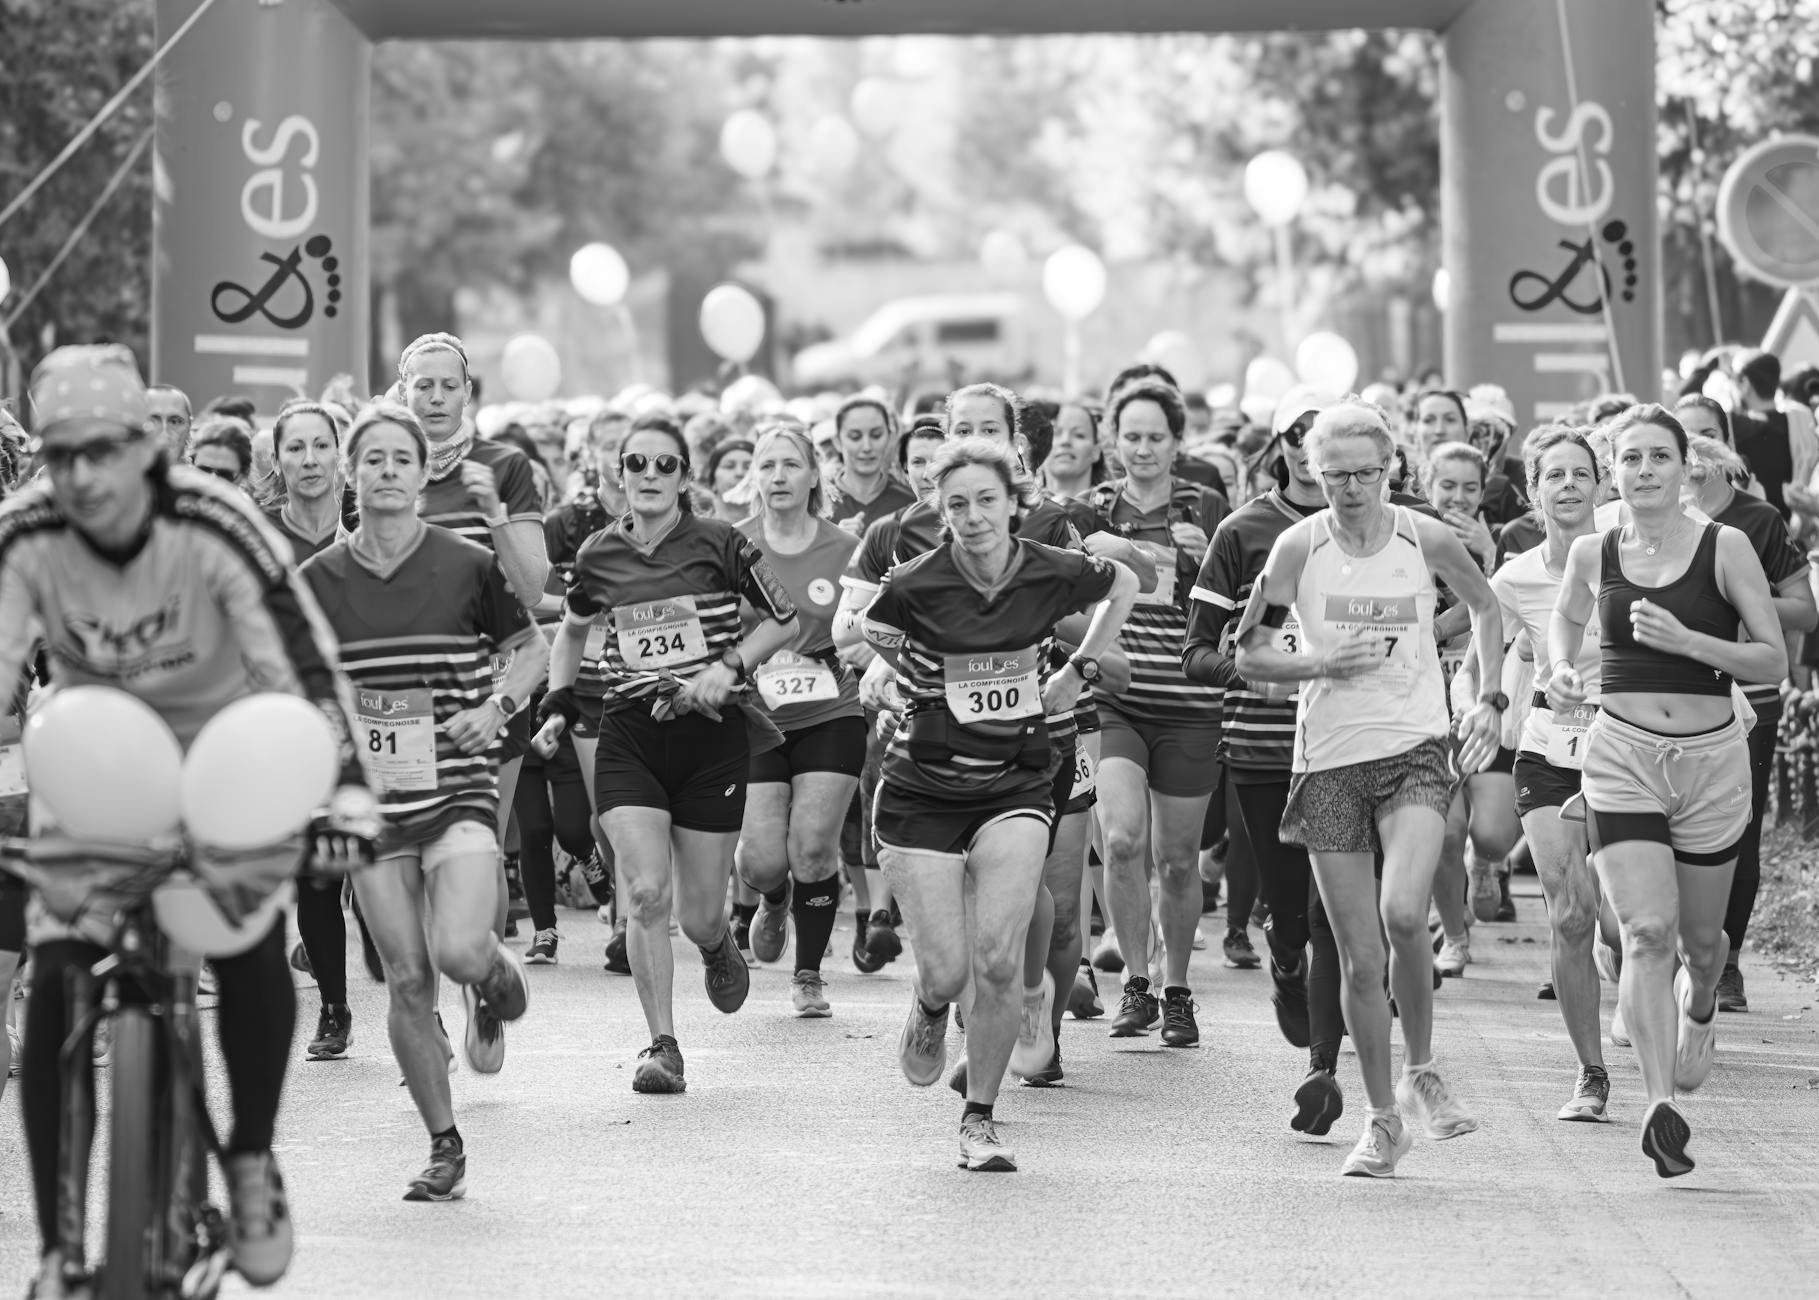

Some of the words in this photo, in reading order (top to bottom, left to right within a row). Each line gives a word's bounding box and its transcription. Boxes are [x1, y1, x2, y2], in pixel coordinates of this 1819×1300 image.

[638, 633, 685, 658] 234
[1283, 634, 1297, 654] 3
[775, 676, 817, 696] 327
[970, 675, 1029, 688] COMPIEGNOISE
[968, 687, 1020, 713] 300
[369, 729, 396, 754] 81
[1567, 736, 1579, 757] 1
